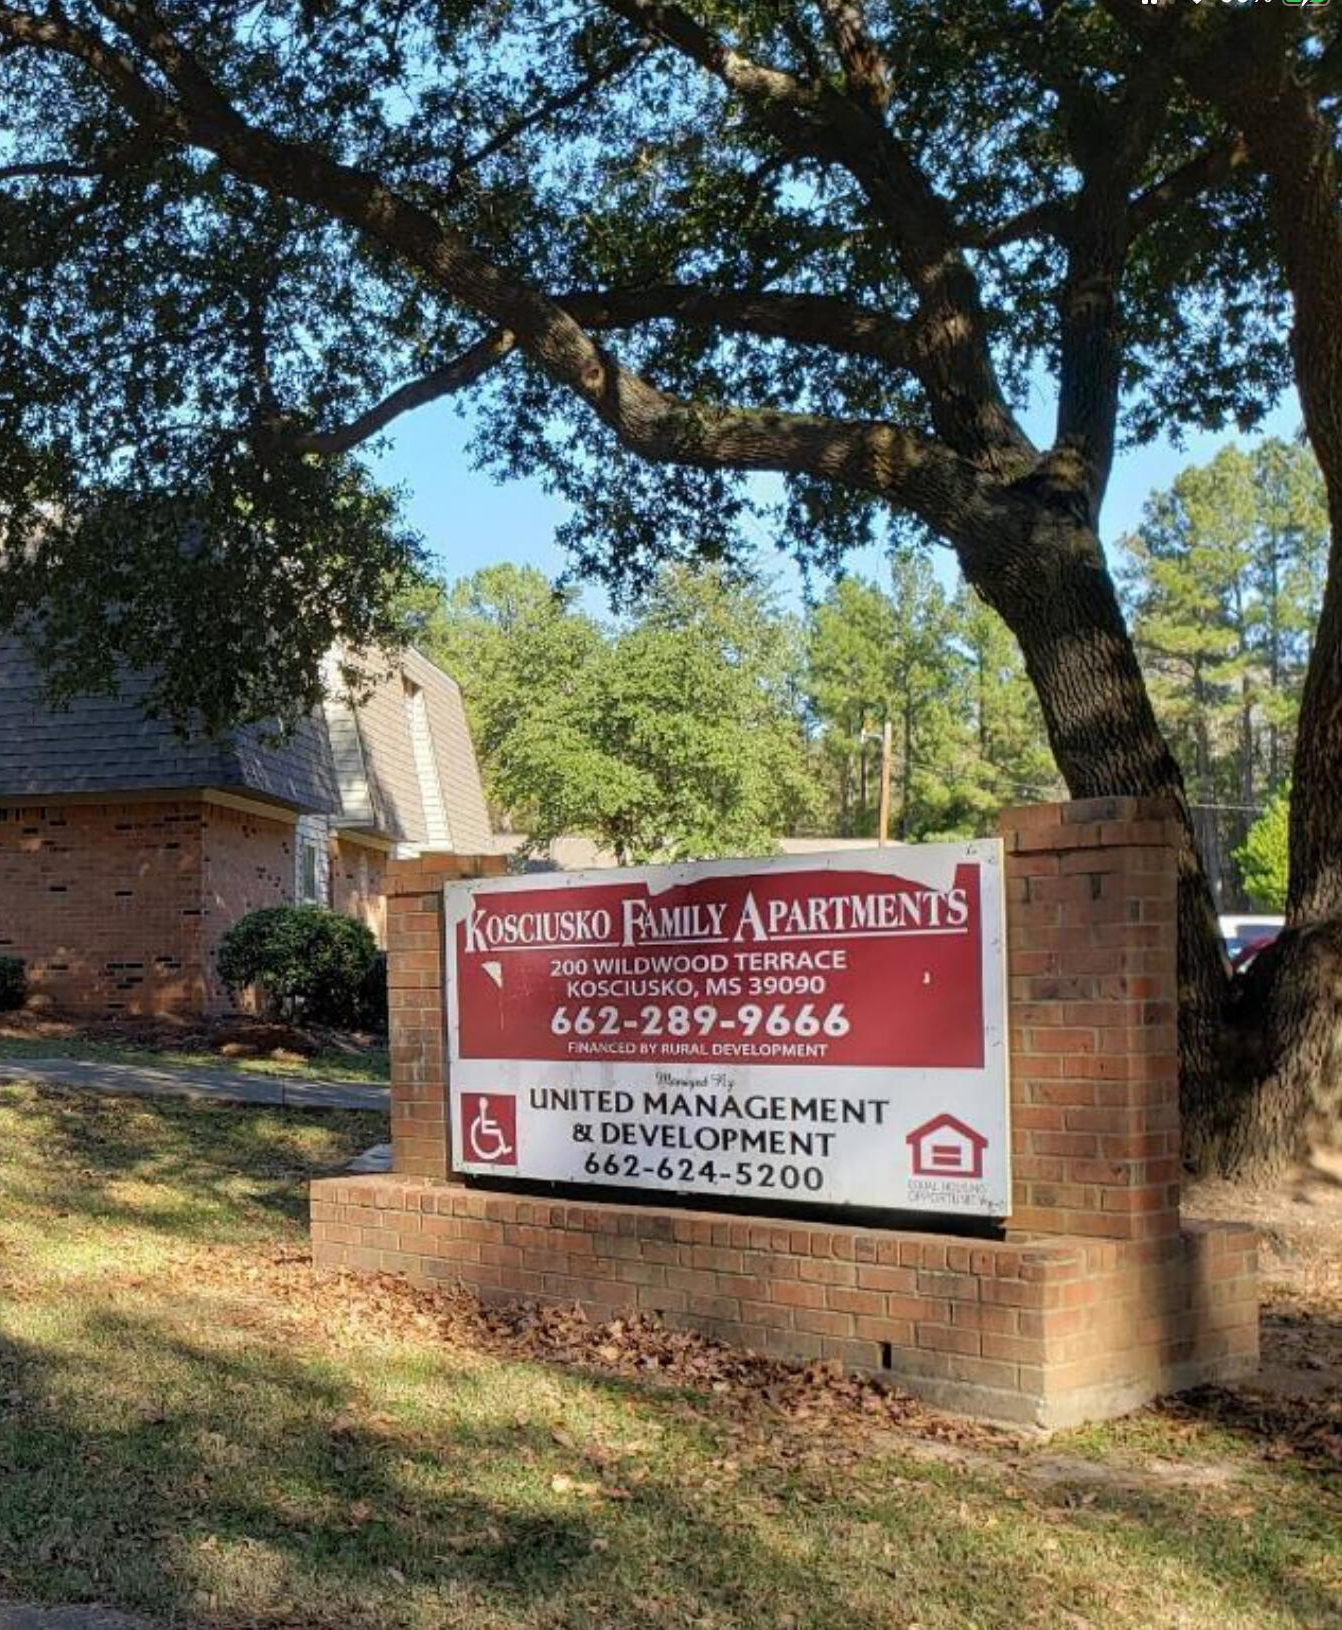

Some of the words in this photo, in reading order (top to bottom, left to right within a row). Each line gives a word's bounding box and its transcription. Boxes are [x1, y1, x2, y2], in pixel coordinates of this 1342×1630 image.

[464, 908, 612, 953] KOSCIUSKO
[621, 898, 728, 948] FAMILY
[733, 888, 969, 944] APARTMENTS
[550, 959, 588, 977] 200
[592, 953, 728, 976] WILDWOOD
[734, 949, 847, 972] TERRACE
[567, 977, 699, 999] KOSCIUSKO,
[705, 977, 742, 996] MS
[748, 975, 826, 996] 39090
[550, 1003, 850, 1037] 662-289-9666
[568, 1041, 636, 1054] FINANCED
[640, 1043, 657, 1055] BY
[661, 1043, 708, 1056] RURAL
[713, 1043, 829, 1058] DEVELOPMENT
[530, 1088, 634, 1113] UNITED
[643, 1092, 890, 1124] MANAGEMENT
[572, 1122, 595, 1143] &
[601, 1122, 837, 1157] DEVELOPMENT
[584, 1153, 824, 1191] 662-624-5200
